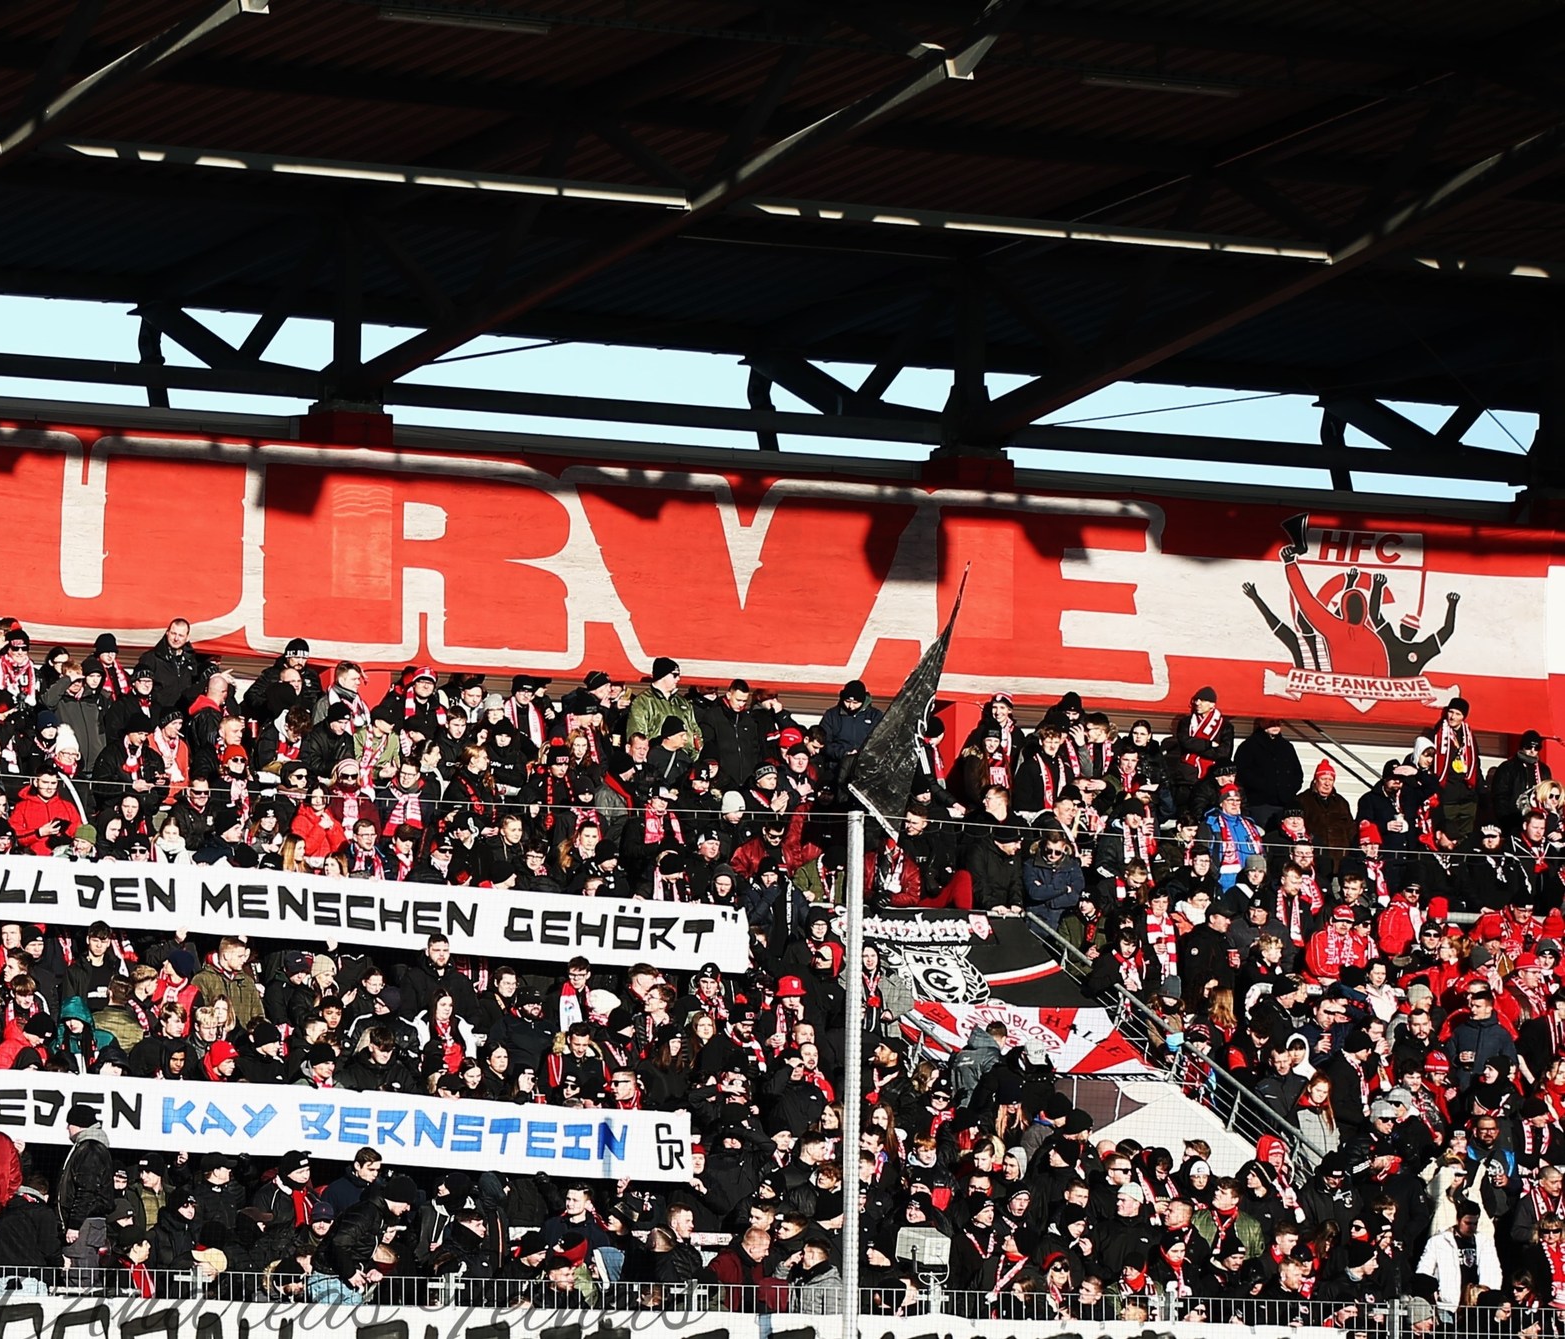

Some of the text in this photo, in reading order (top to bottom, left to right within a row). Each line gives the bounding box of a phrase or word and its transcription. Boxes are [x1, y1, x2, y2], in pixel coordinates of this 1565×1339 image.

[1319, 530, 1403, 564] HFC
[1290, 672, 1429, 692] HFC-FANKURVE
[74, 873, 176, 913] DEN
[200, 881, 479, 937] MENSCHEN
[912, 954, 948, 967] HFC
[161, 1096, 278, 1139] KAY
[299, 1103, 628, 1162] BERNSTEIN
